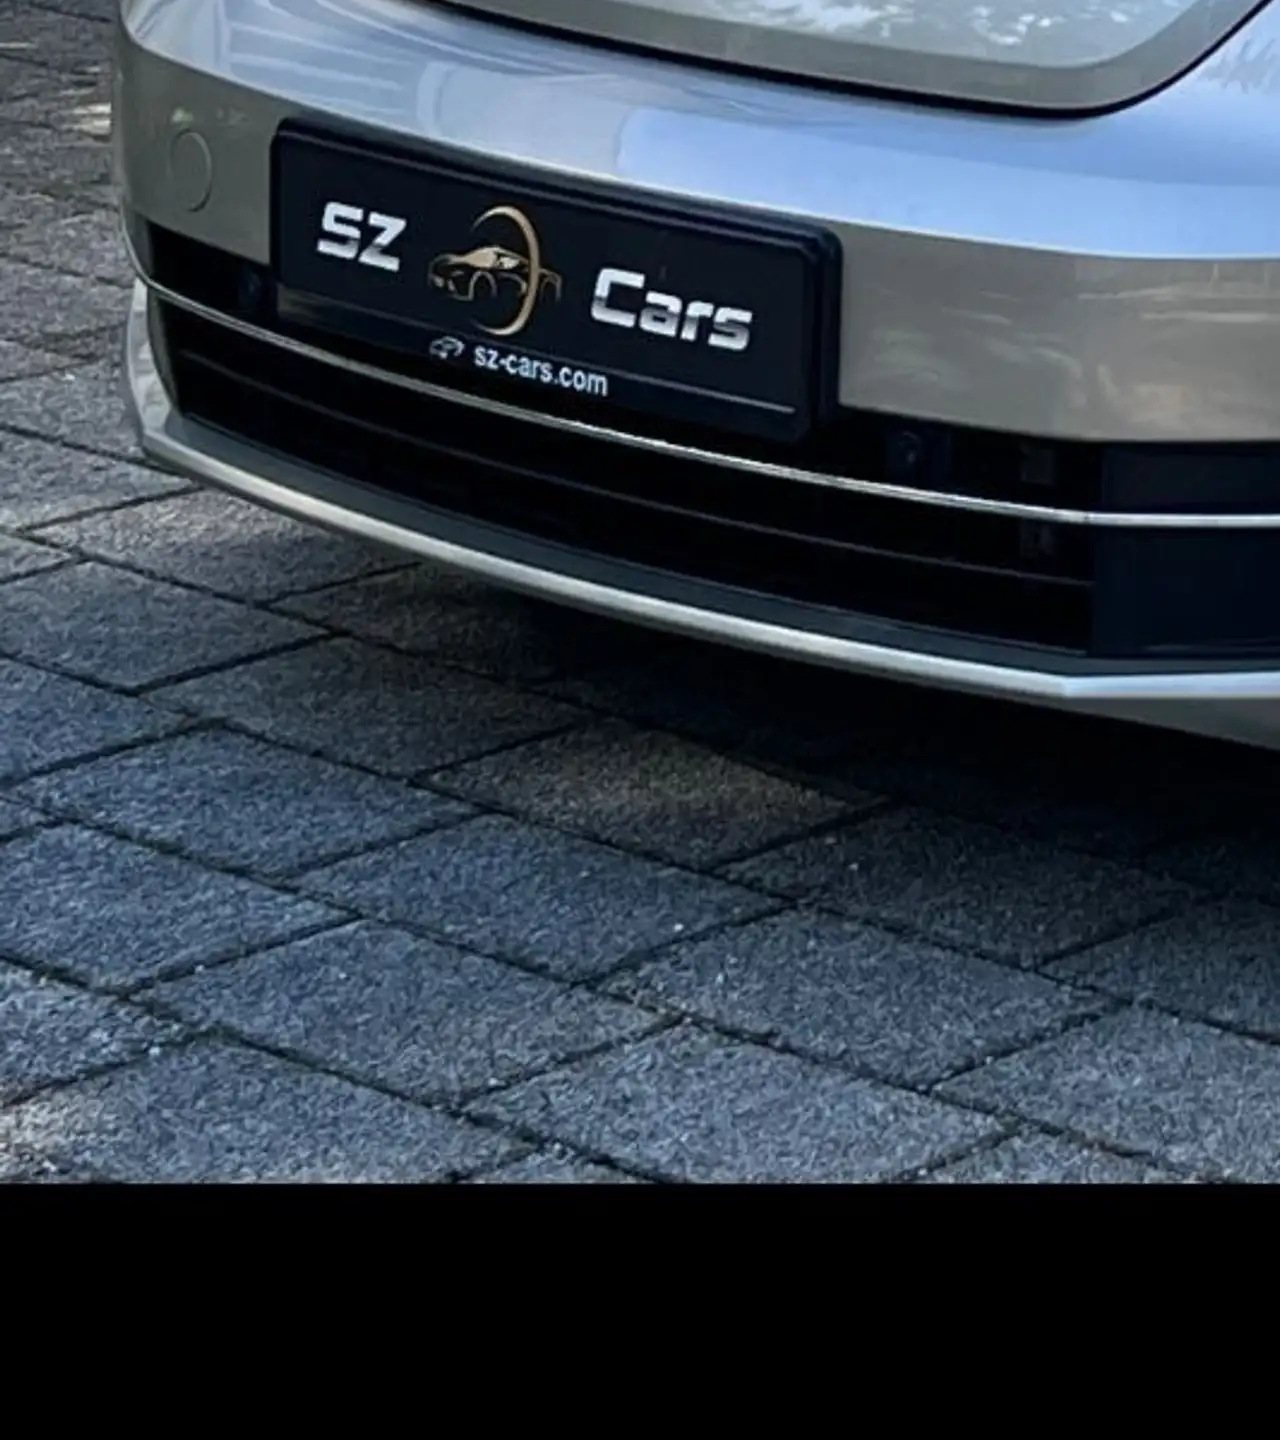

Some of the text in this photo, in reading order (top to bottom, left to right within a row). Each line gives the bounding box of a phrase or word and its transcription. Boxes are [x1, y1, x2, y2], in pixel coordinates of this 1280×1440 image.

[316, 201, 753, 351] SZ Cars
[474, 345, 608, 397] sz-cars.com
